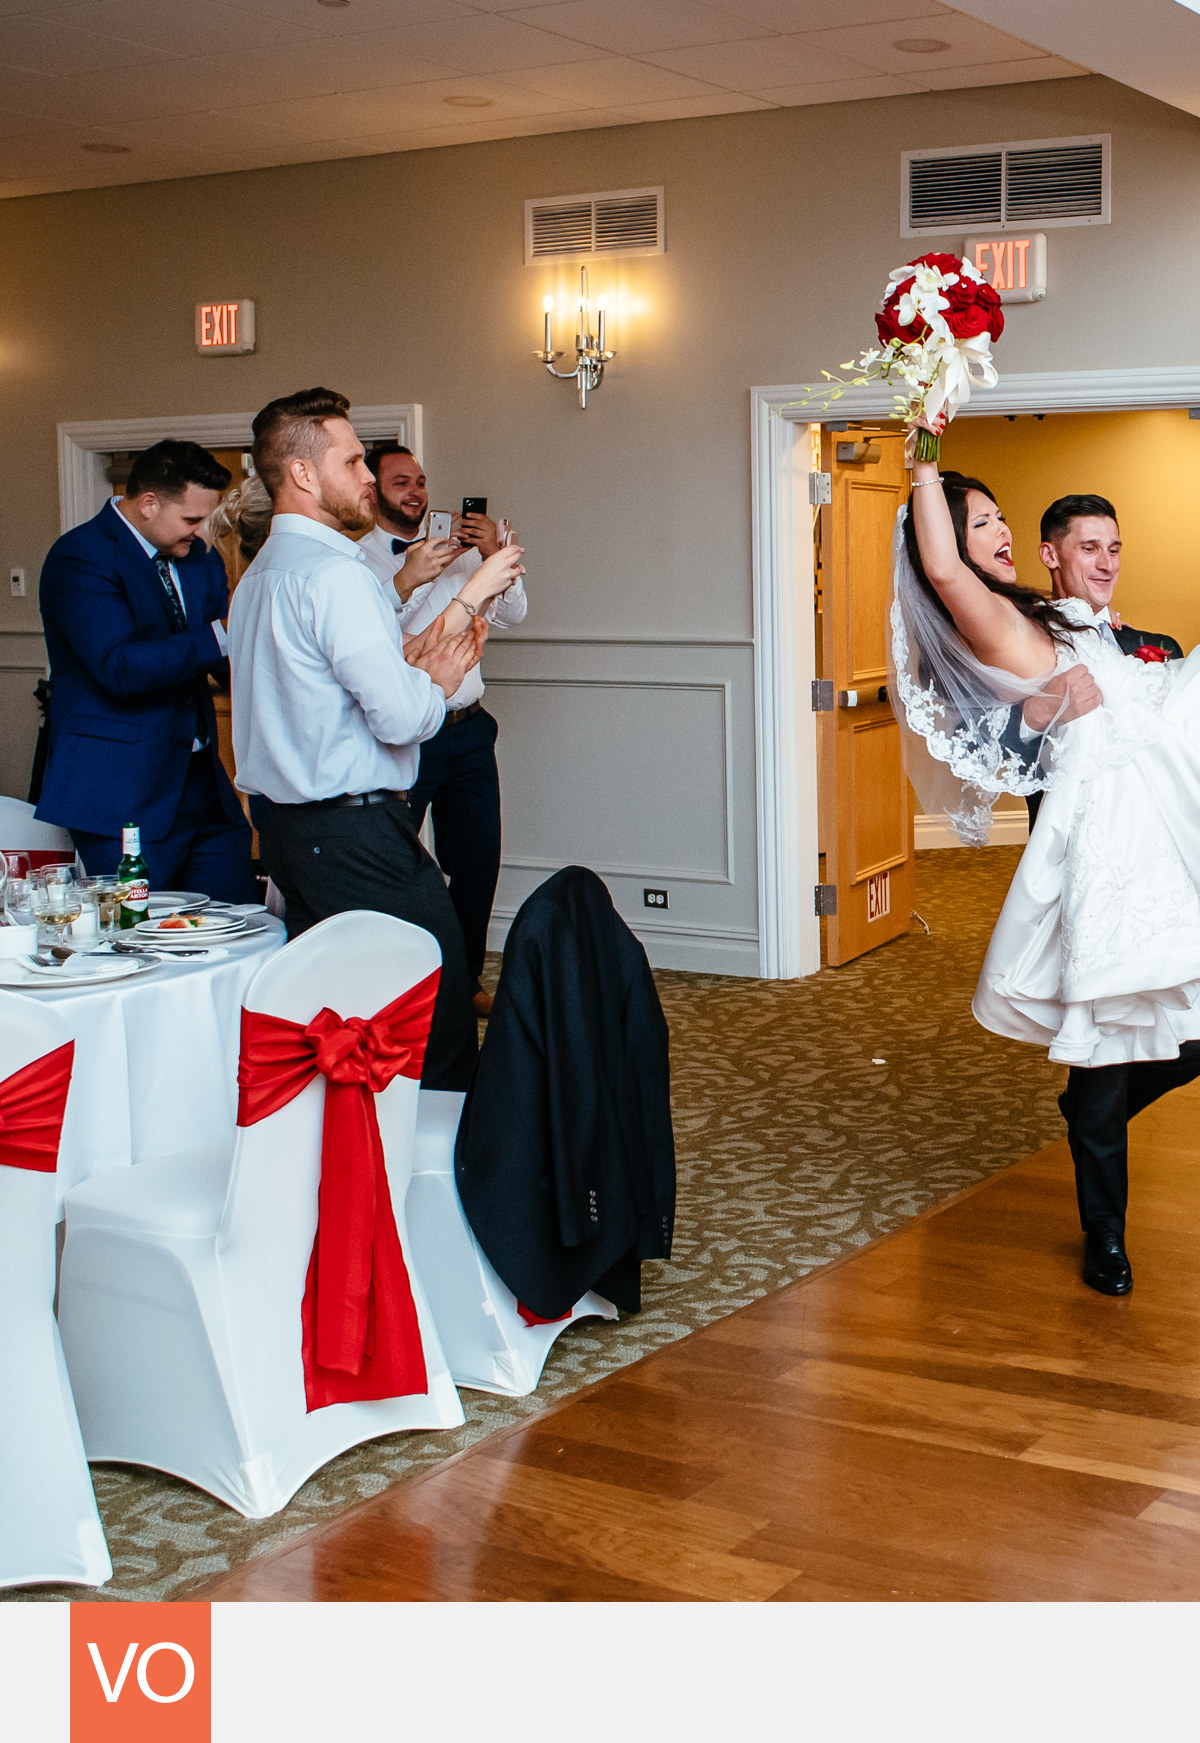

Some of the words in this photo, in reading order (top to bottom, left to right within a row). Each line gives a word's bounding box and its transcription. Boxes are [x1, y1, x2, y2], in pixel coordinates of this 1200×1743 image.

[975, 240, 1030, 290] EXIT
[201, 304, 239, 346] EXIT
[869, 871, 888, 919] EXIT
